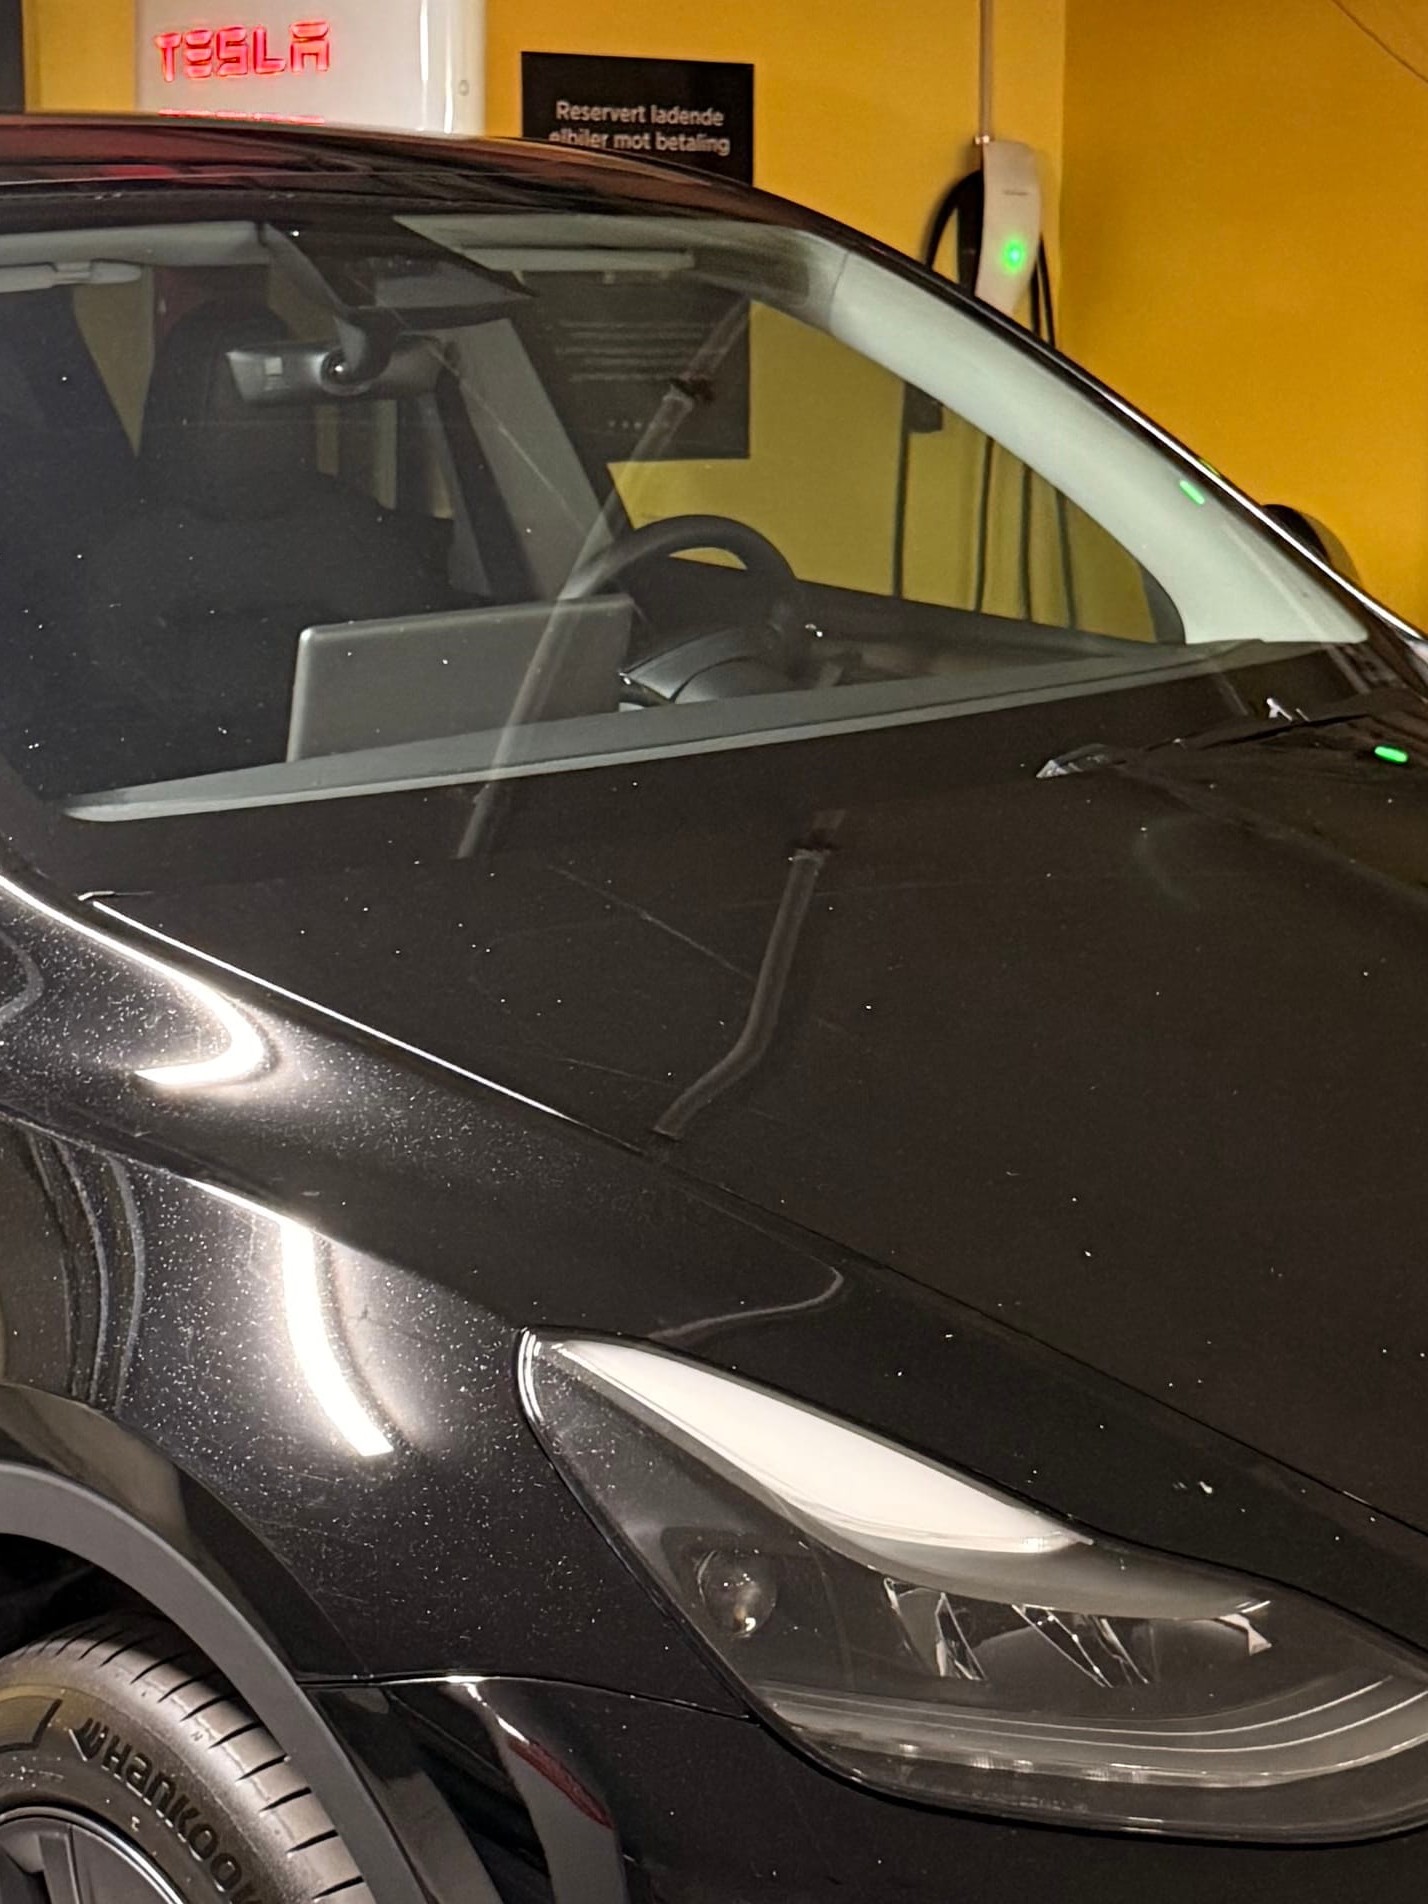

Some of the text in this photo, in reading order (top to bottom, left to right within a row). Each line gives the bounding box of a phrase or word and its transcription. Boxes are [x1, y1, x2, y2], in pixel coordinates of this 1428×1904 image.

[155, 21, 329, 82] TESLA
[556, 100, 724, 126] Reservert ladende
[613, 132, 652, 150] mot
[655, 131, 730, 157] betaling
